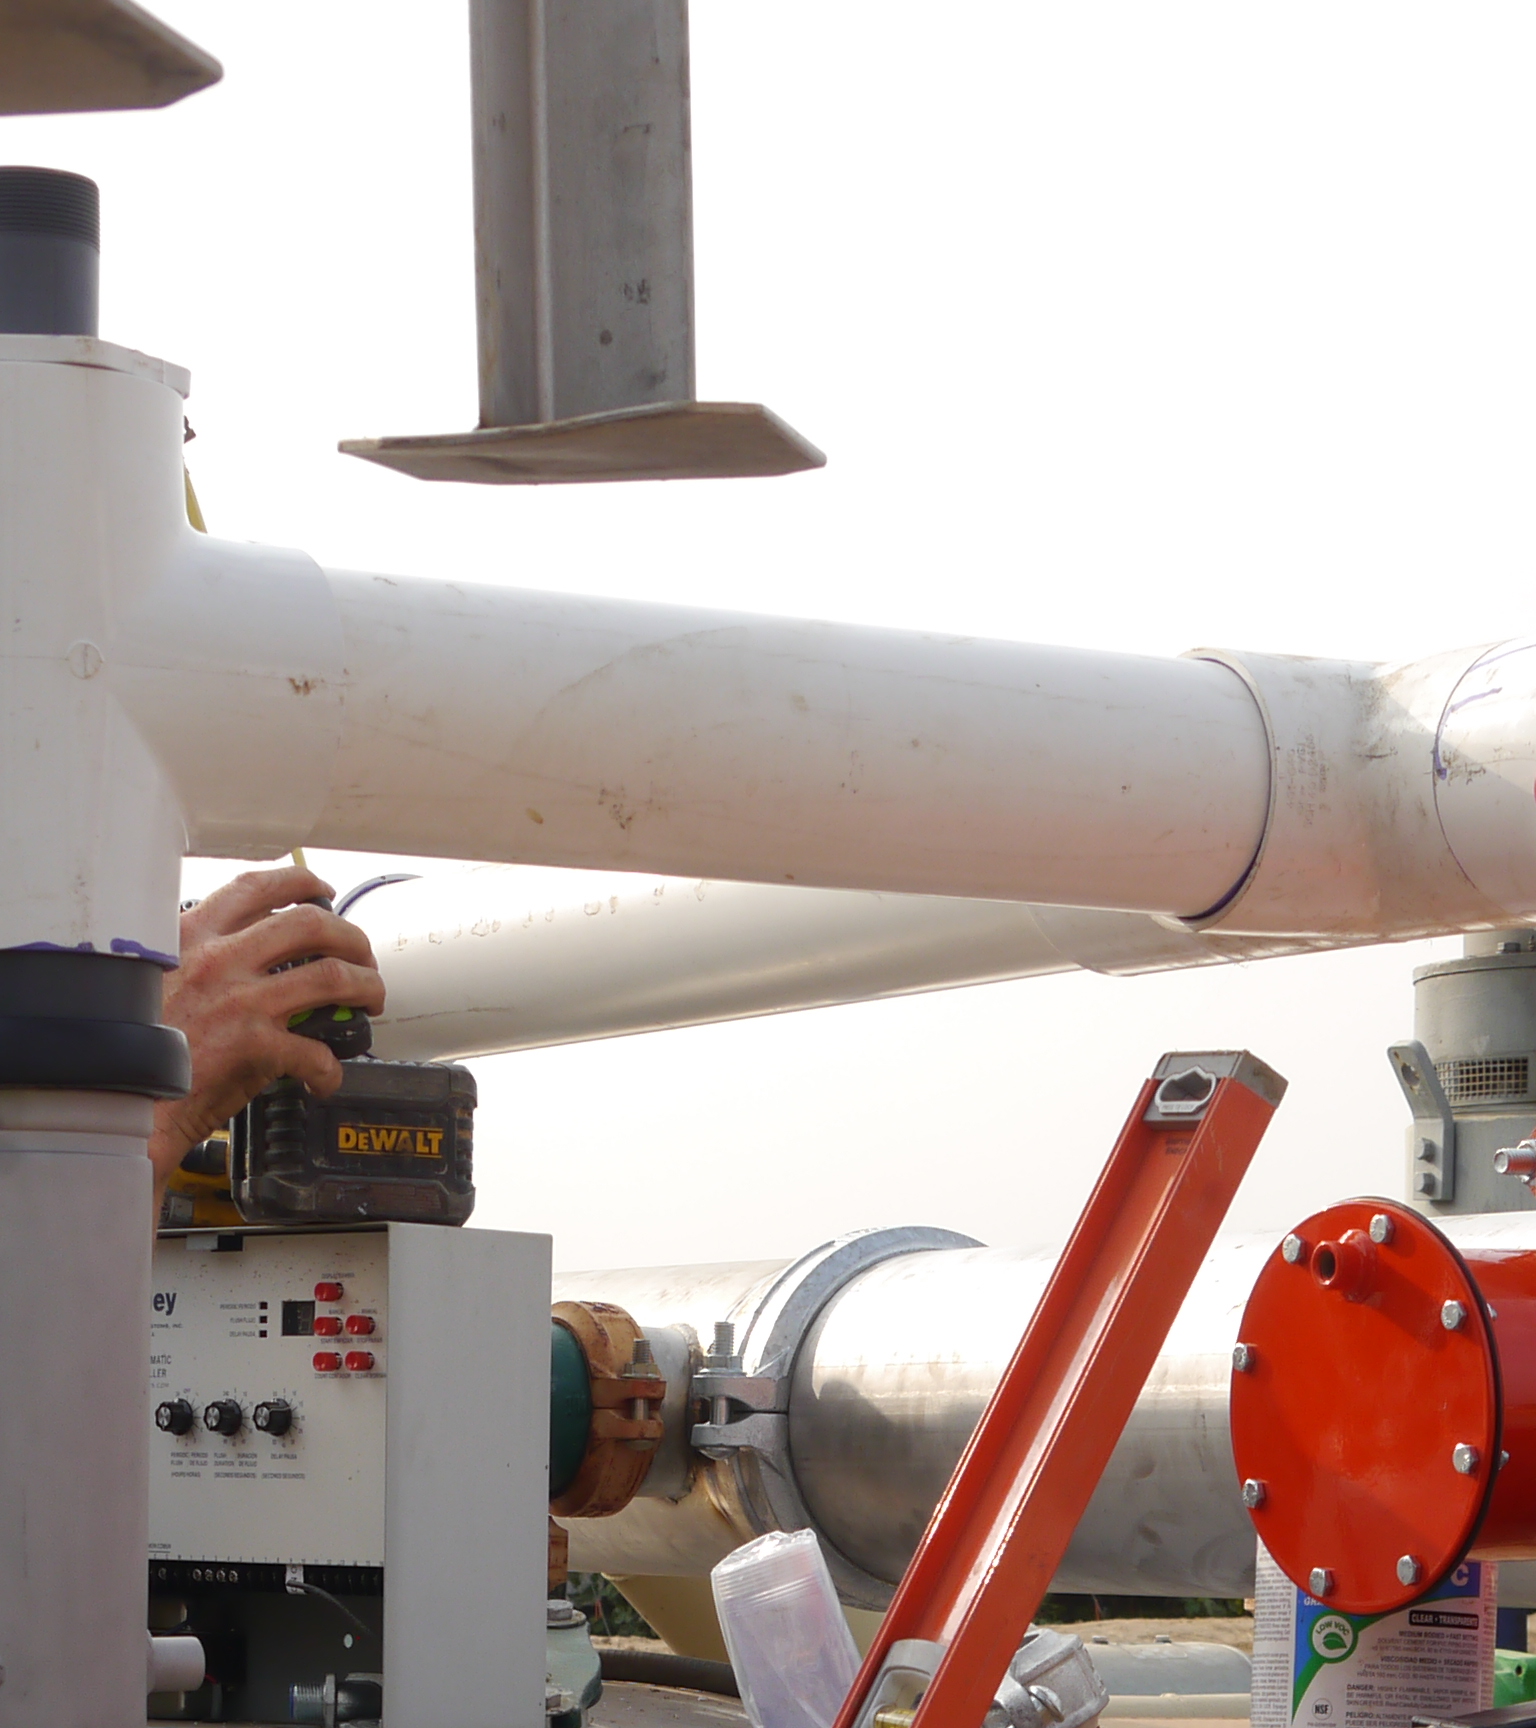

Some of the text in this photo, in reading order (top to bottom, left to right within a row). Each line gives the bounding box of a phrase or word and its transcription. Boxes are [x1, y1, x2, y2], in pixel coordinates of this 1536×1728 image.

[1411, 1613, 1433, 1623] CLEAR
[1316, 1620, 1350, 1635] LOW VOC
[1314, 1703, 1329, 1714] NSF
